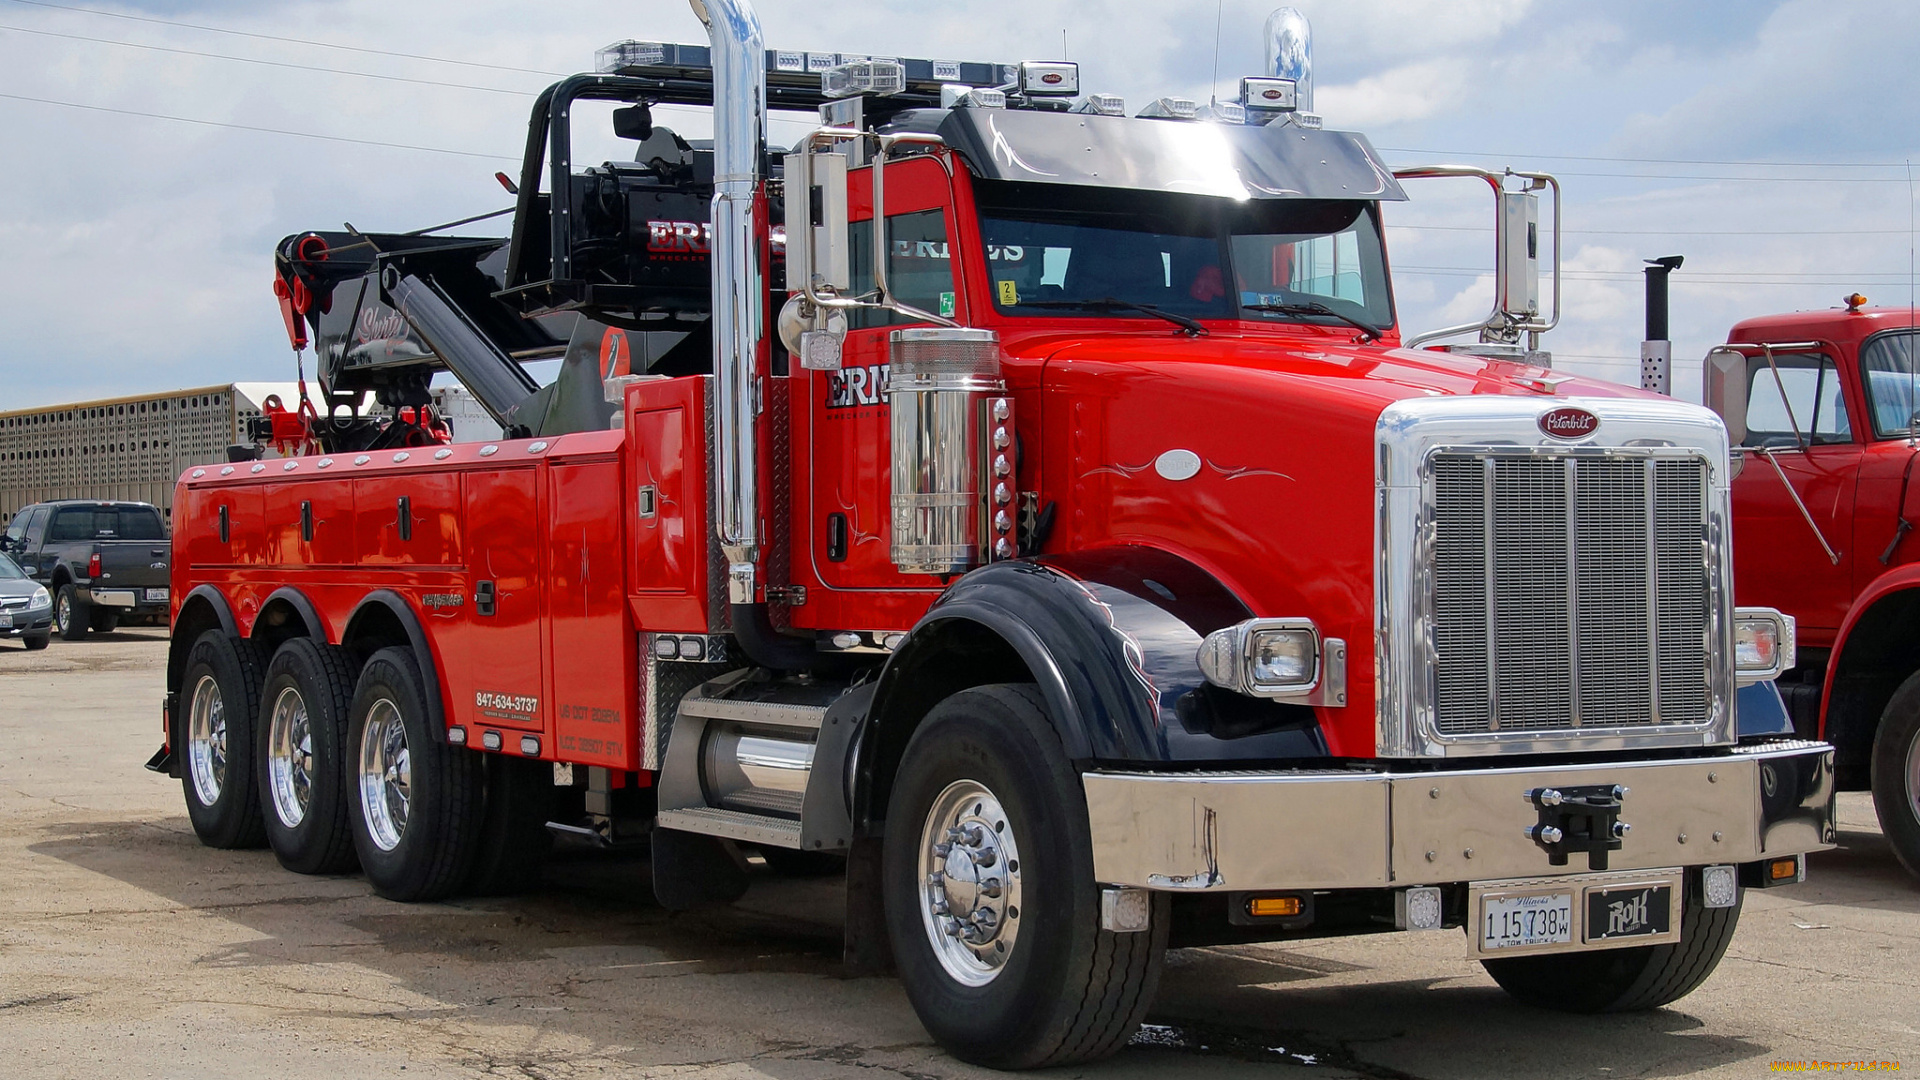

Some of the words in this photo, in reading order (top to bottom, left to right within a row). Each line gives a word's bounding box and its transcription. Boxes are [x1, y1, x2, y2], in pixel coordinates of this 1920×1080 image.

[1004, 282, 1010, 293] 2
[1547, 412, 1594, 431] Peterbilt
[476, 691, 538, 713] 847-634-3737
[572, 705, 589, 720] DOT
